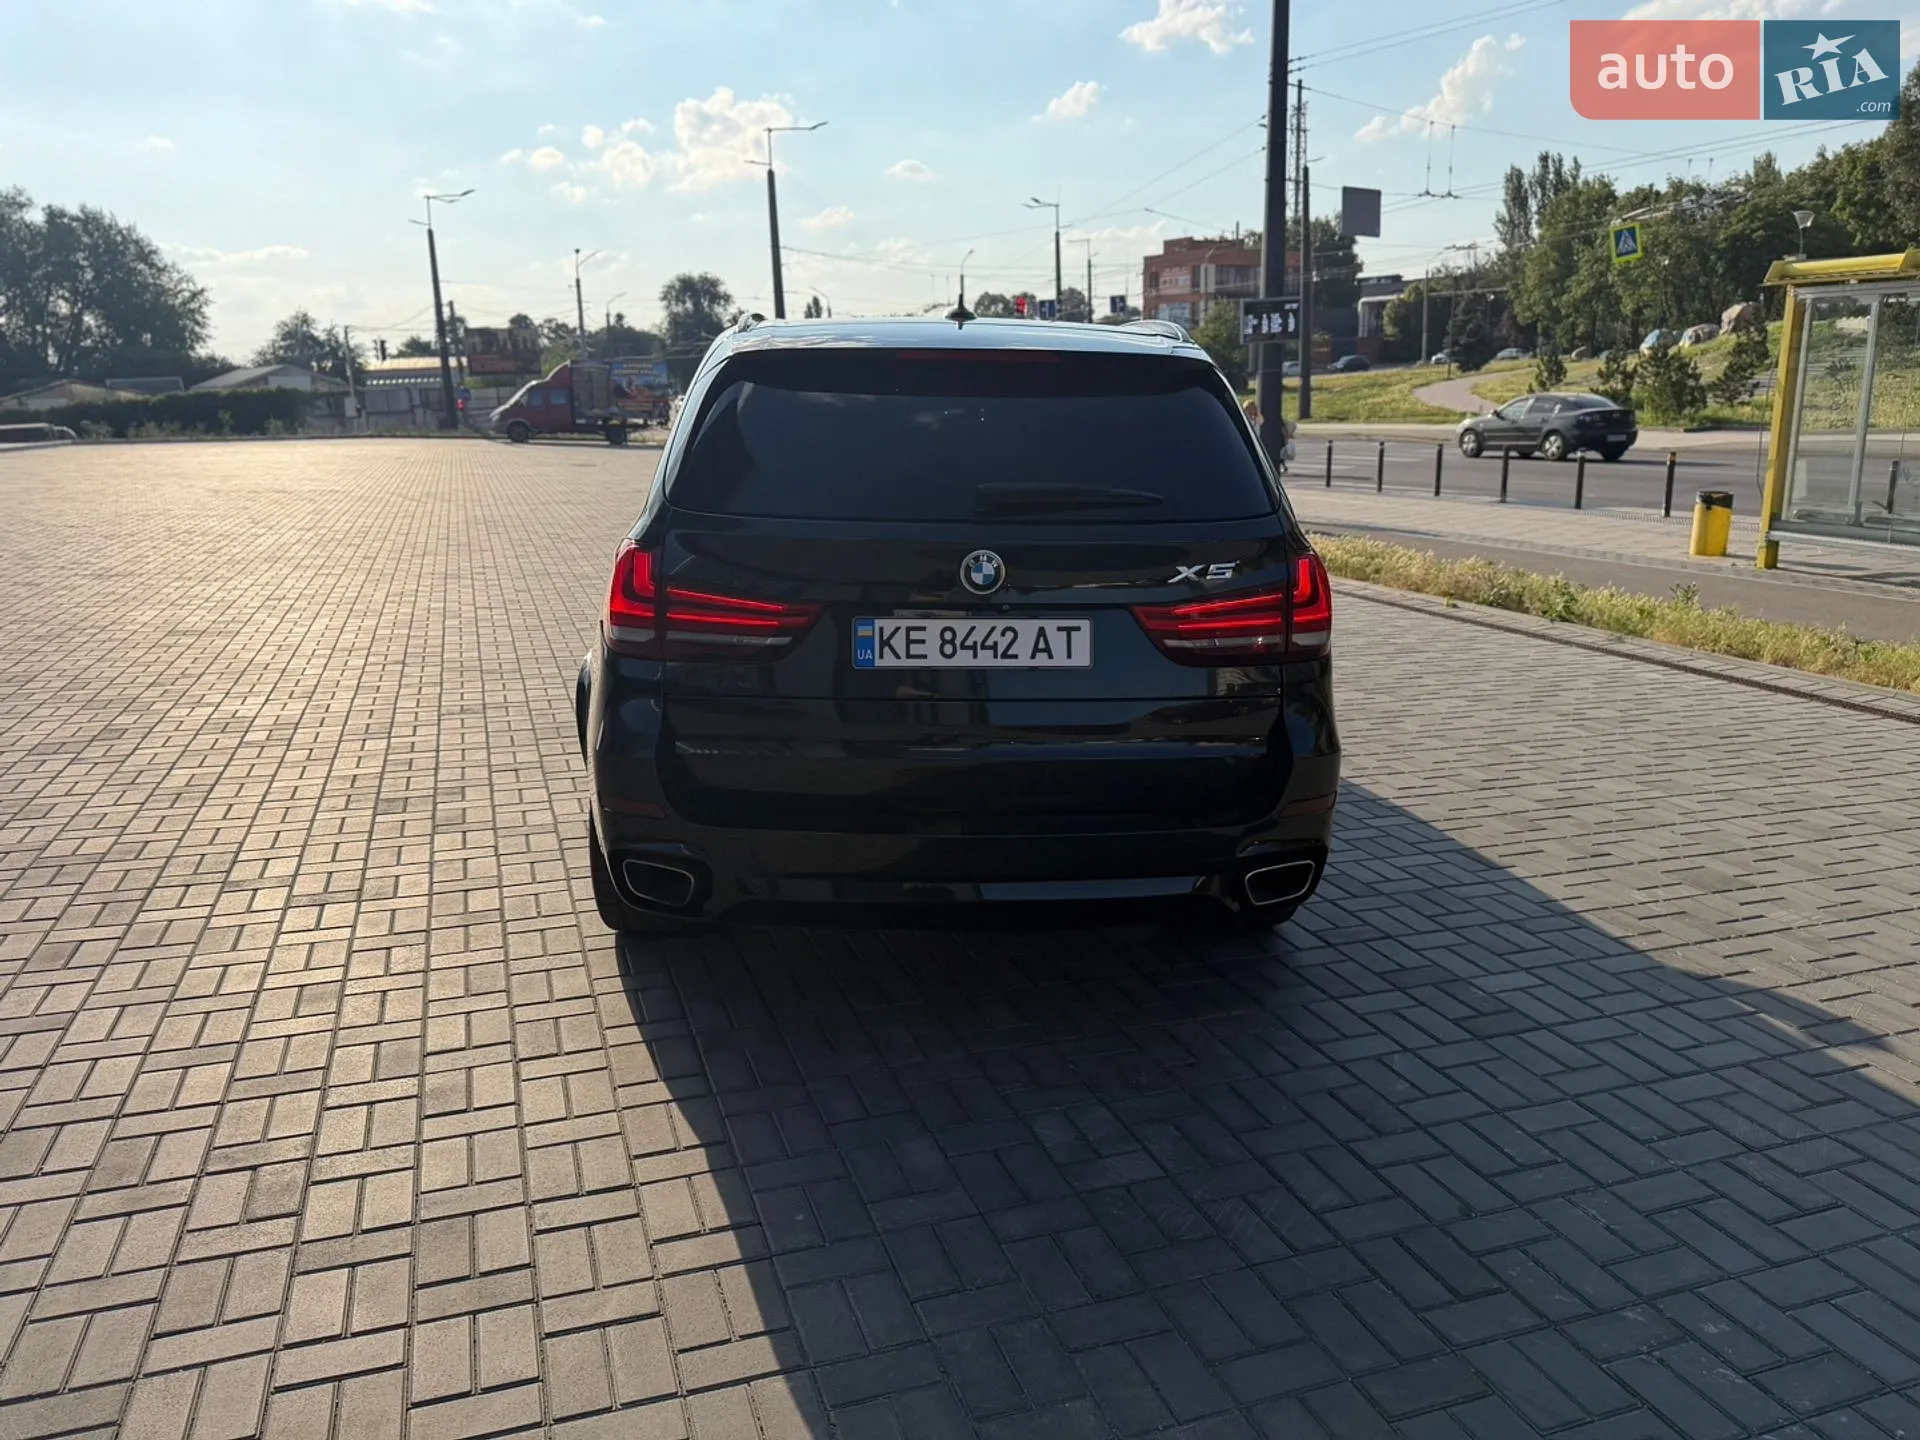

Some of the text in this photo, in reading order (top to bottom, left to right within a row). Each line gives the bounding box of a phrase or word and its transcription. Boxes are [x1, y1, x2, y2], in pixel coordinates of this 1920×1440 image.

[1168, 560, 1238, 583] X5
[857, 648, 873, 660] UA
[878, 626, 1081, 660] KE 8442 AT
